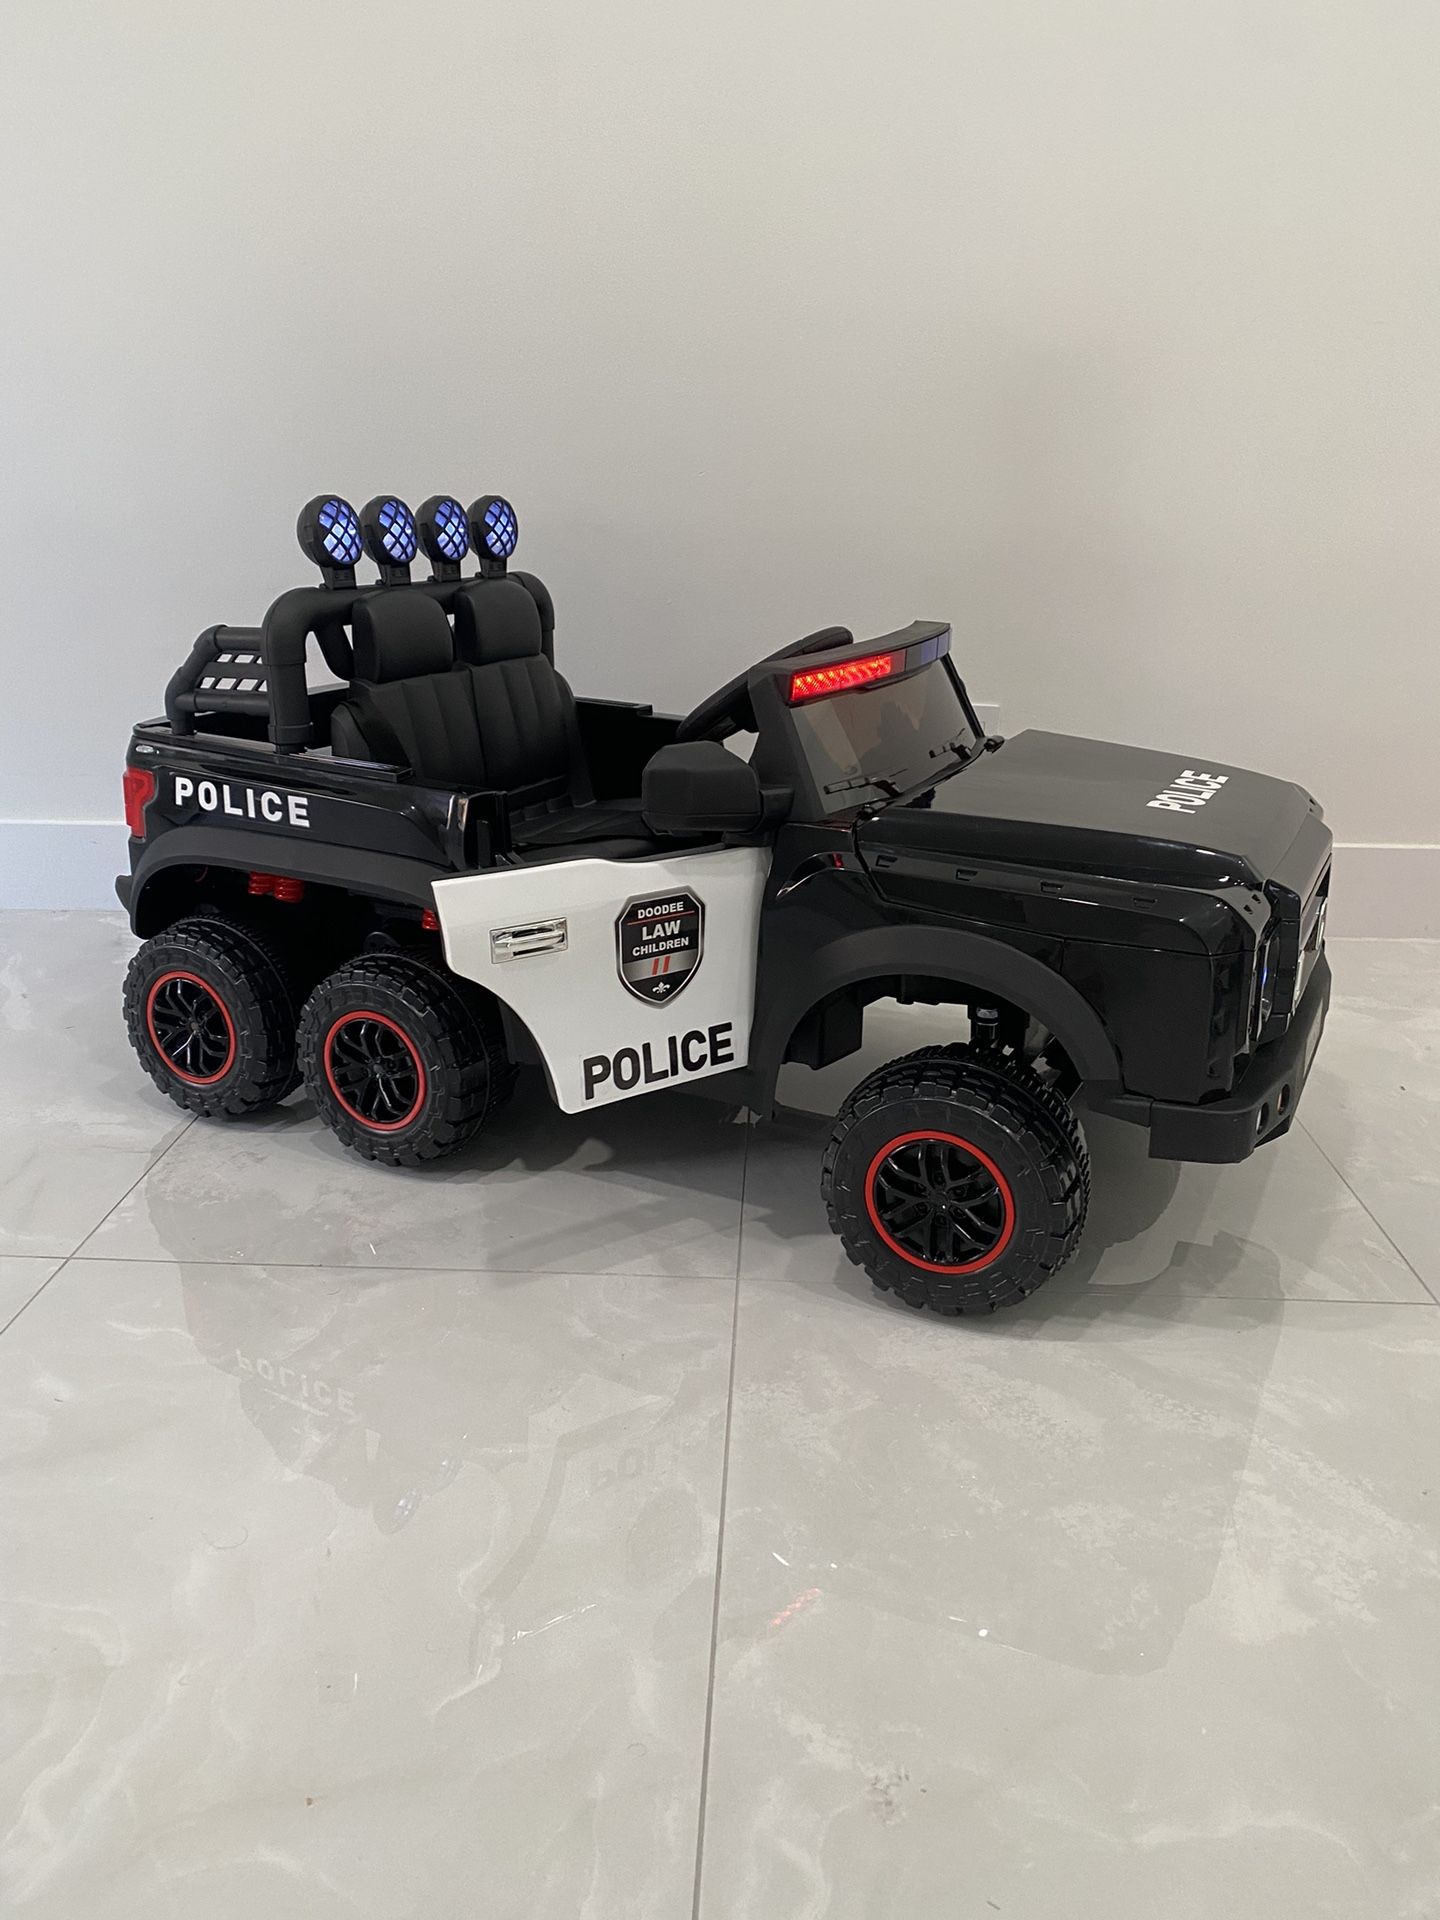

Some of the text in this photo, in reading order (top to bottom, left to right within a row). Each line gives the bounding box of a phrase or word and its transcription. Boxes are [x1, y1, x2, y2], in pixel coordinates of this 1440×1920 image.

[174, 776, 310, 828] POLICE
[1146, 769, 1229, 814] POLICE
[637, 901, 685, 919] DOODEE
[632, 936, 689, 957] CHILDREN
[641, 919, 681, 941] LAW
[583, 1022, 734, 1100] POLICE
